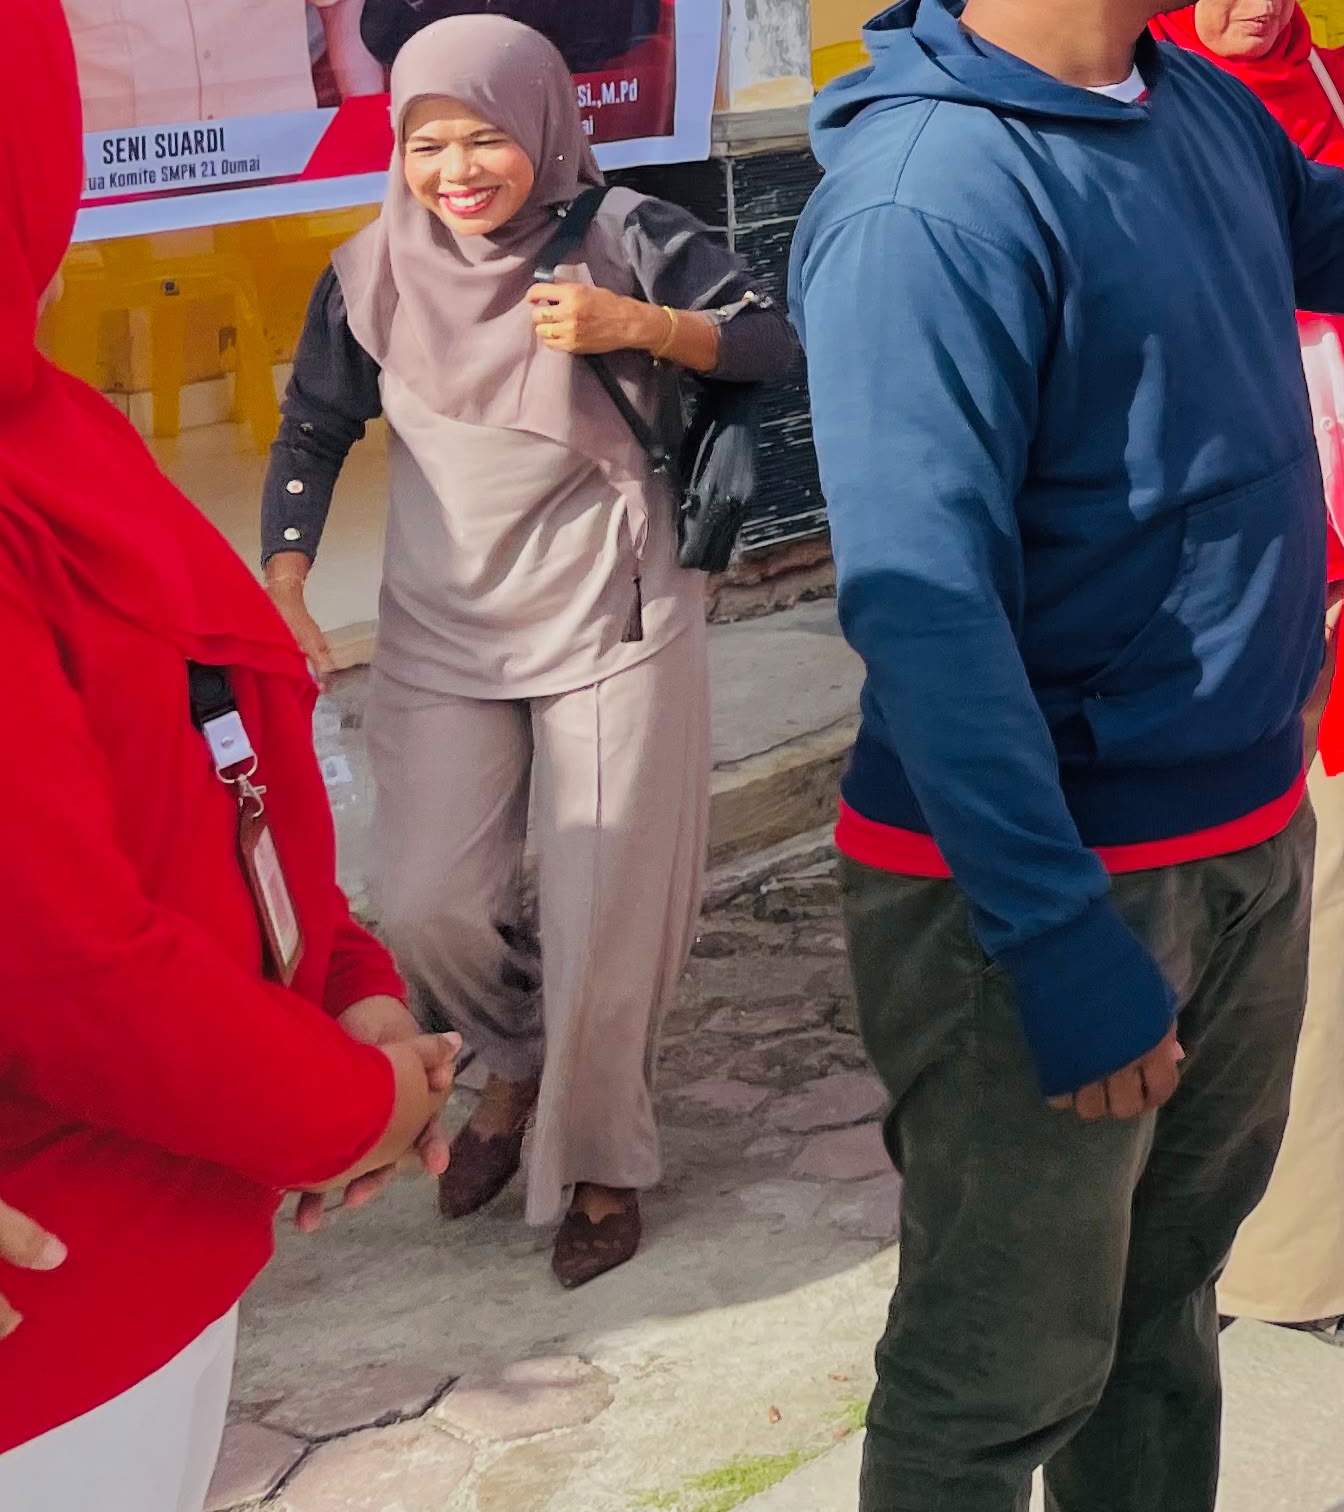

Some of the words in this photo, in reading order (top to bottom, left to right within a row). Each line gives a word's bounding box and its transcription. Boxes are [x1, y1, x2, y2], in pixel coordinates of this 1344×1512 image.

[102, 135, 147, 165] SENI
[154, 127, 226, 159] SUARDI
[84, 175, 106, 192] ua
[109, 168, 157, 188] Komite
[161, 164, 197, 182] SMPN
[200, 160, 217, 178] 21
[221, 154, 261, 176] Dumai
